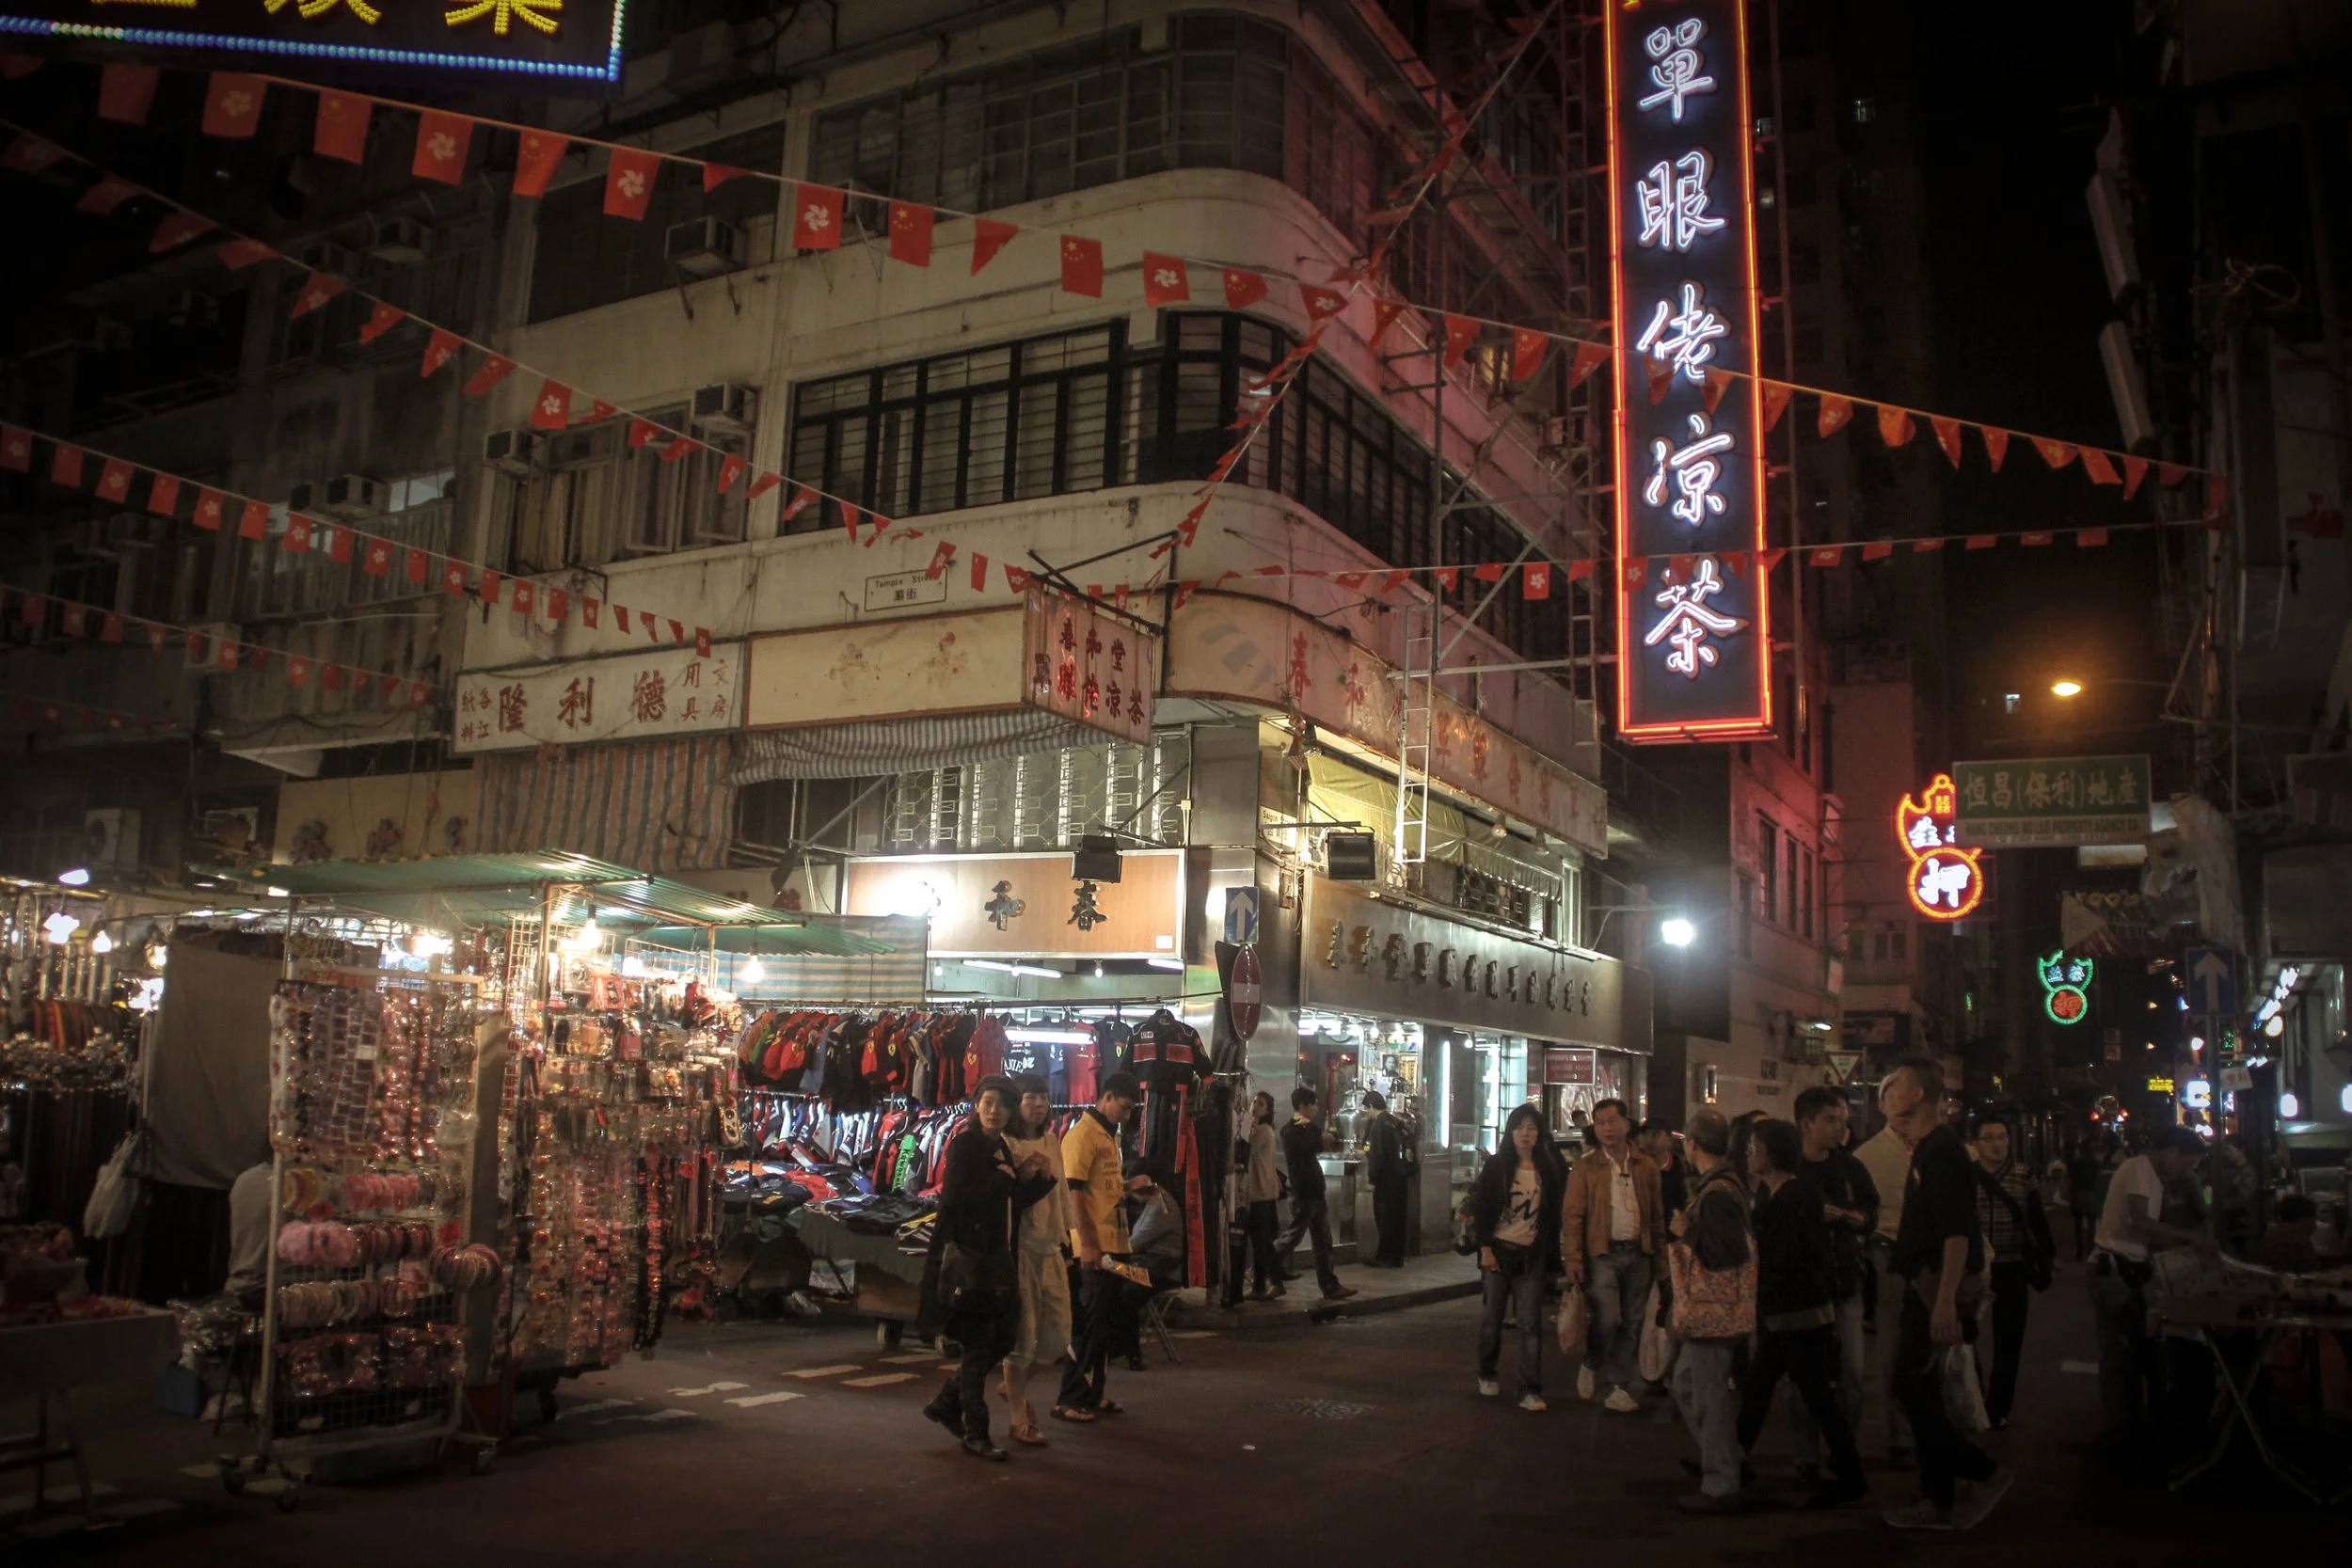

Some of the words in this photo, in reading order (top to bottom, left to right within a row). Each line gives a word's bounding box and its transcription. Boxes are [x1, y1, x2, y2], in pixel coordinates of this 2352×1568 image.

[875, 578, 903, 589] Temple
[498, 669, 666, 734] 德利隆
[1918, 857, 1972, 908] 押
